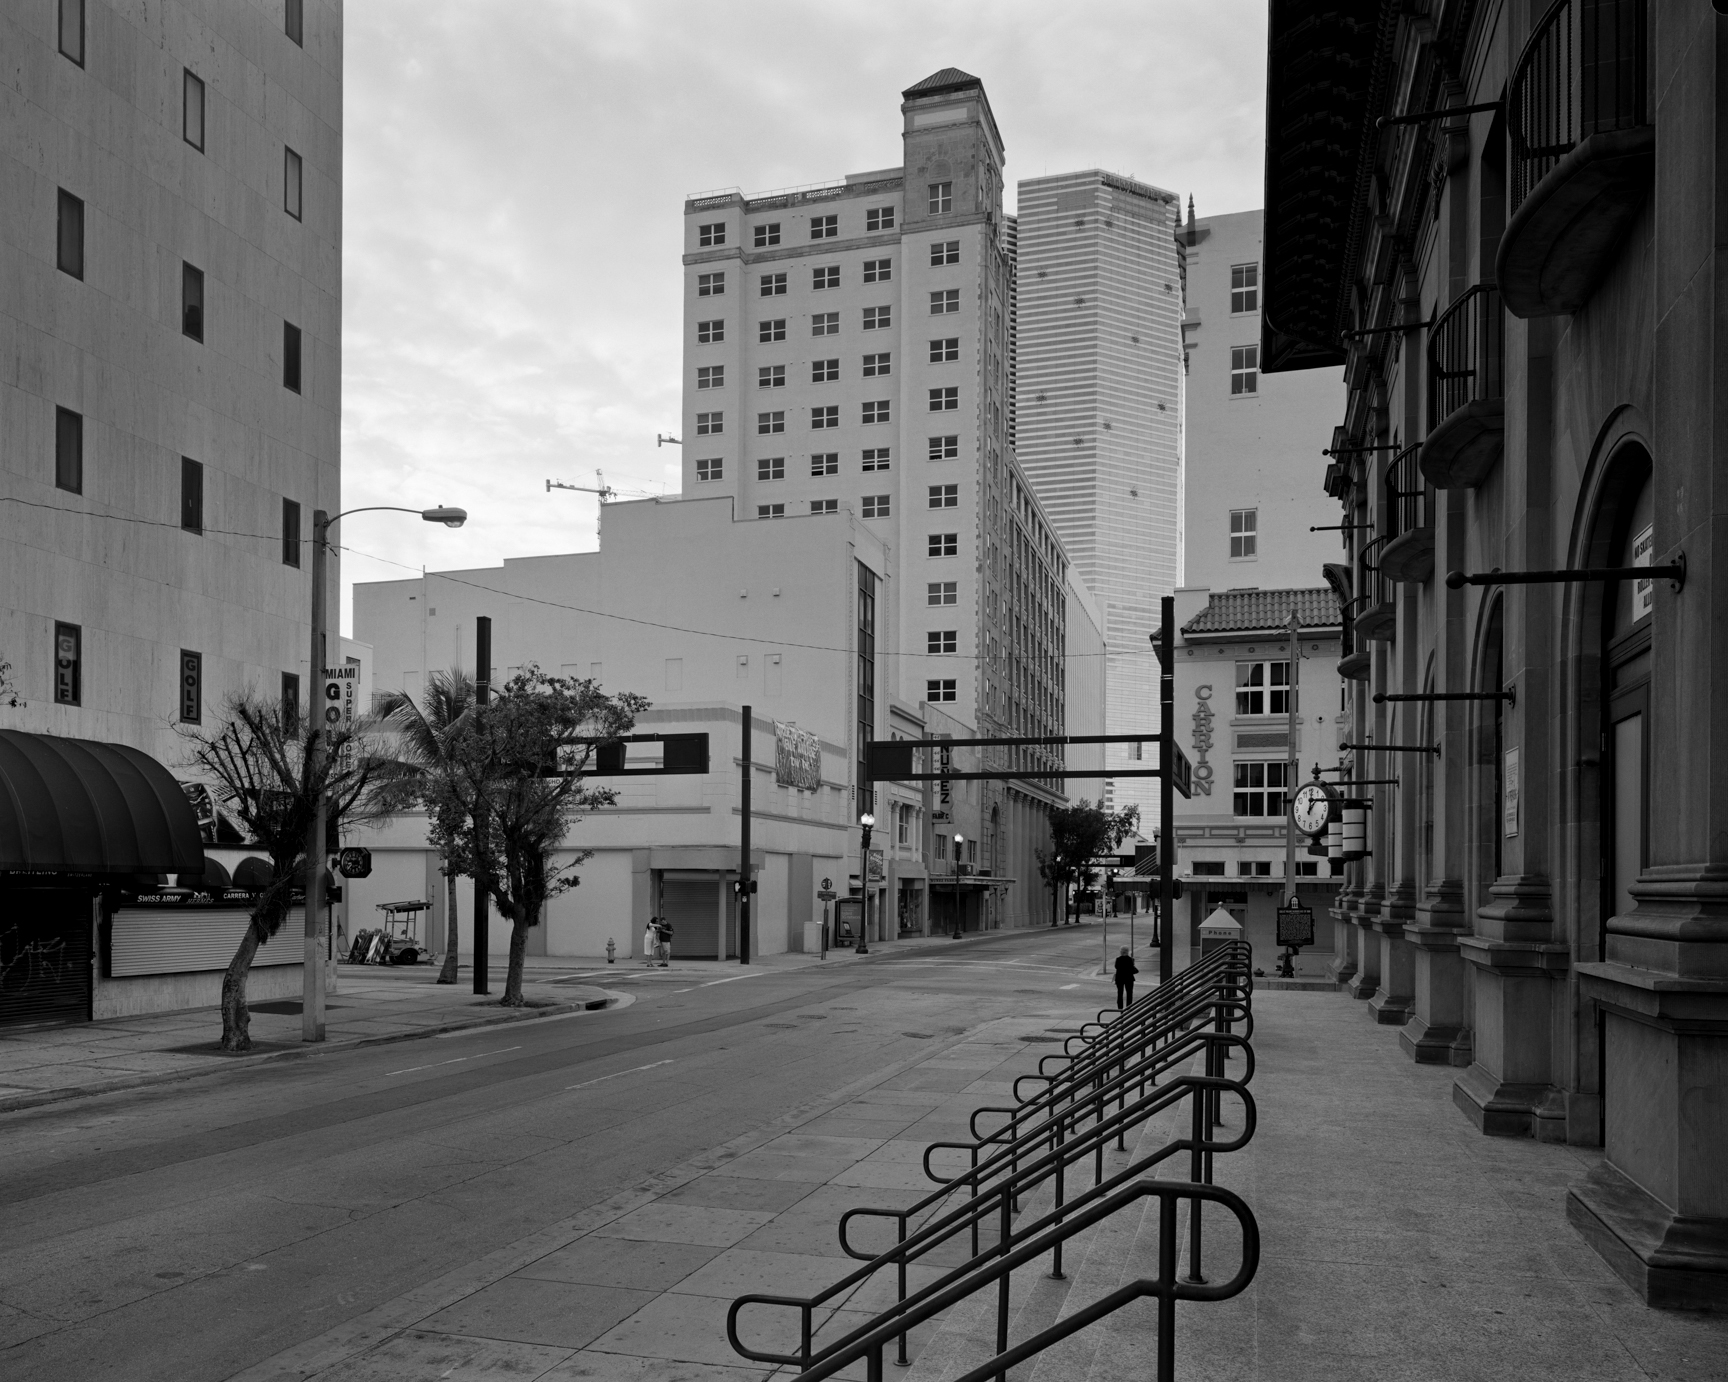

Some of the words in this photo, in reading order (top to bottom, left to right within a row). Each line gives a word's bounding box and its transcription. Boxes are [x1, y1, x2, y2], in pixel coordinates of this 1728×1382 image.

[58, 639, 72, 700] GOLF
[326, 668, 355, 679] MIAMI
[185, 659, 196, 716] GOLF
[1192, 684, 1215, 796] CARRION
[1323, 804, 1327, 812] 3
[1303, 820, 1306, 828] 7
[1309, 822, 1312, 830] 6
[137, 895, 160, 903] SWISS
